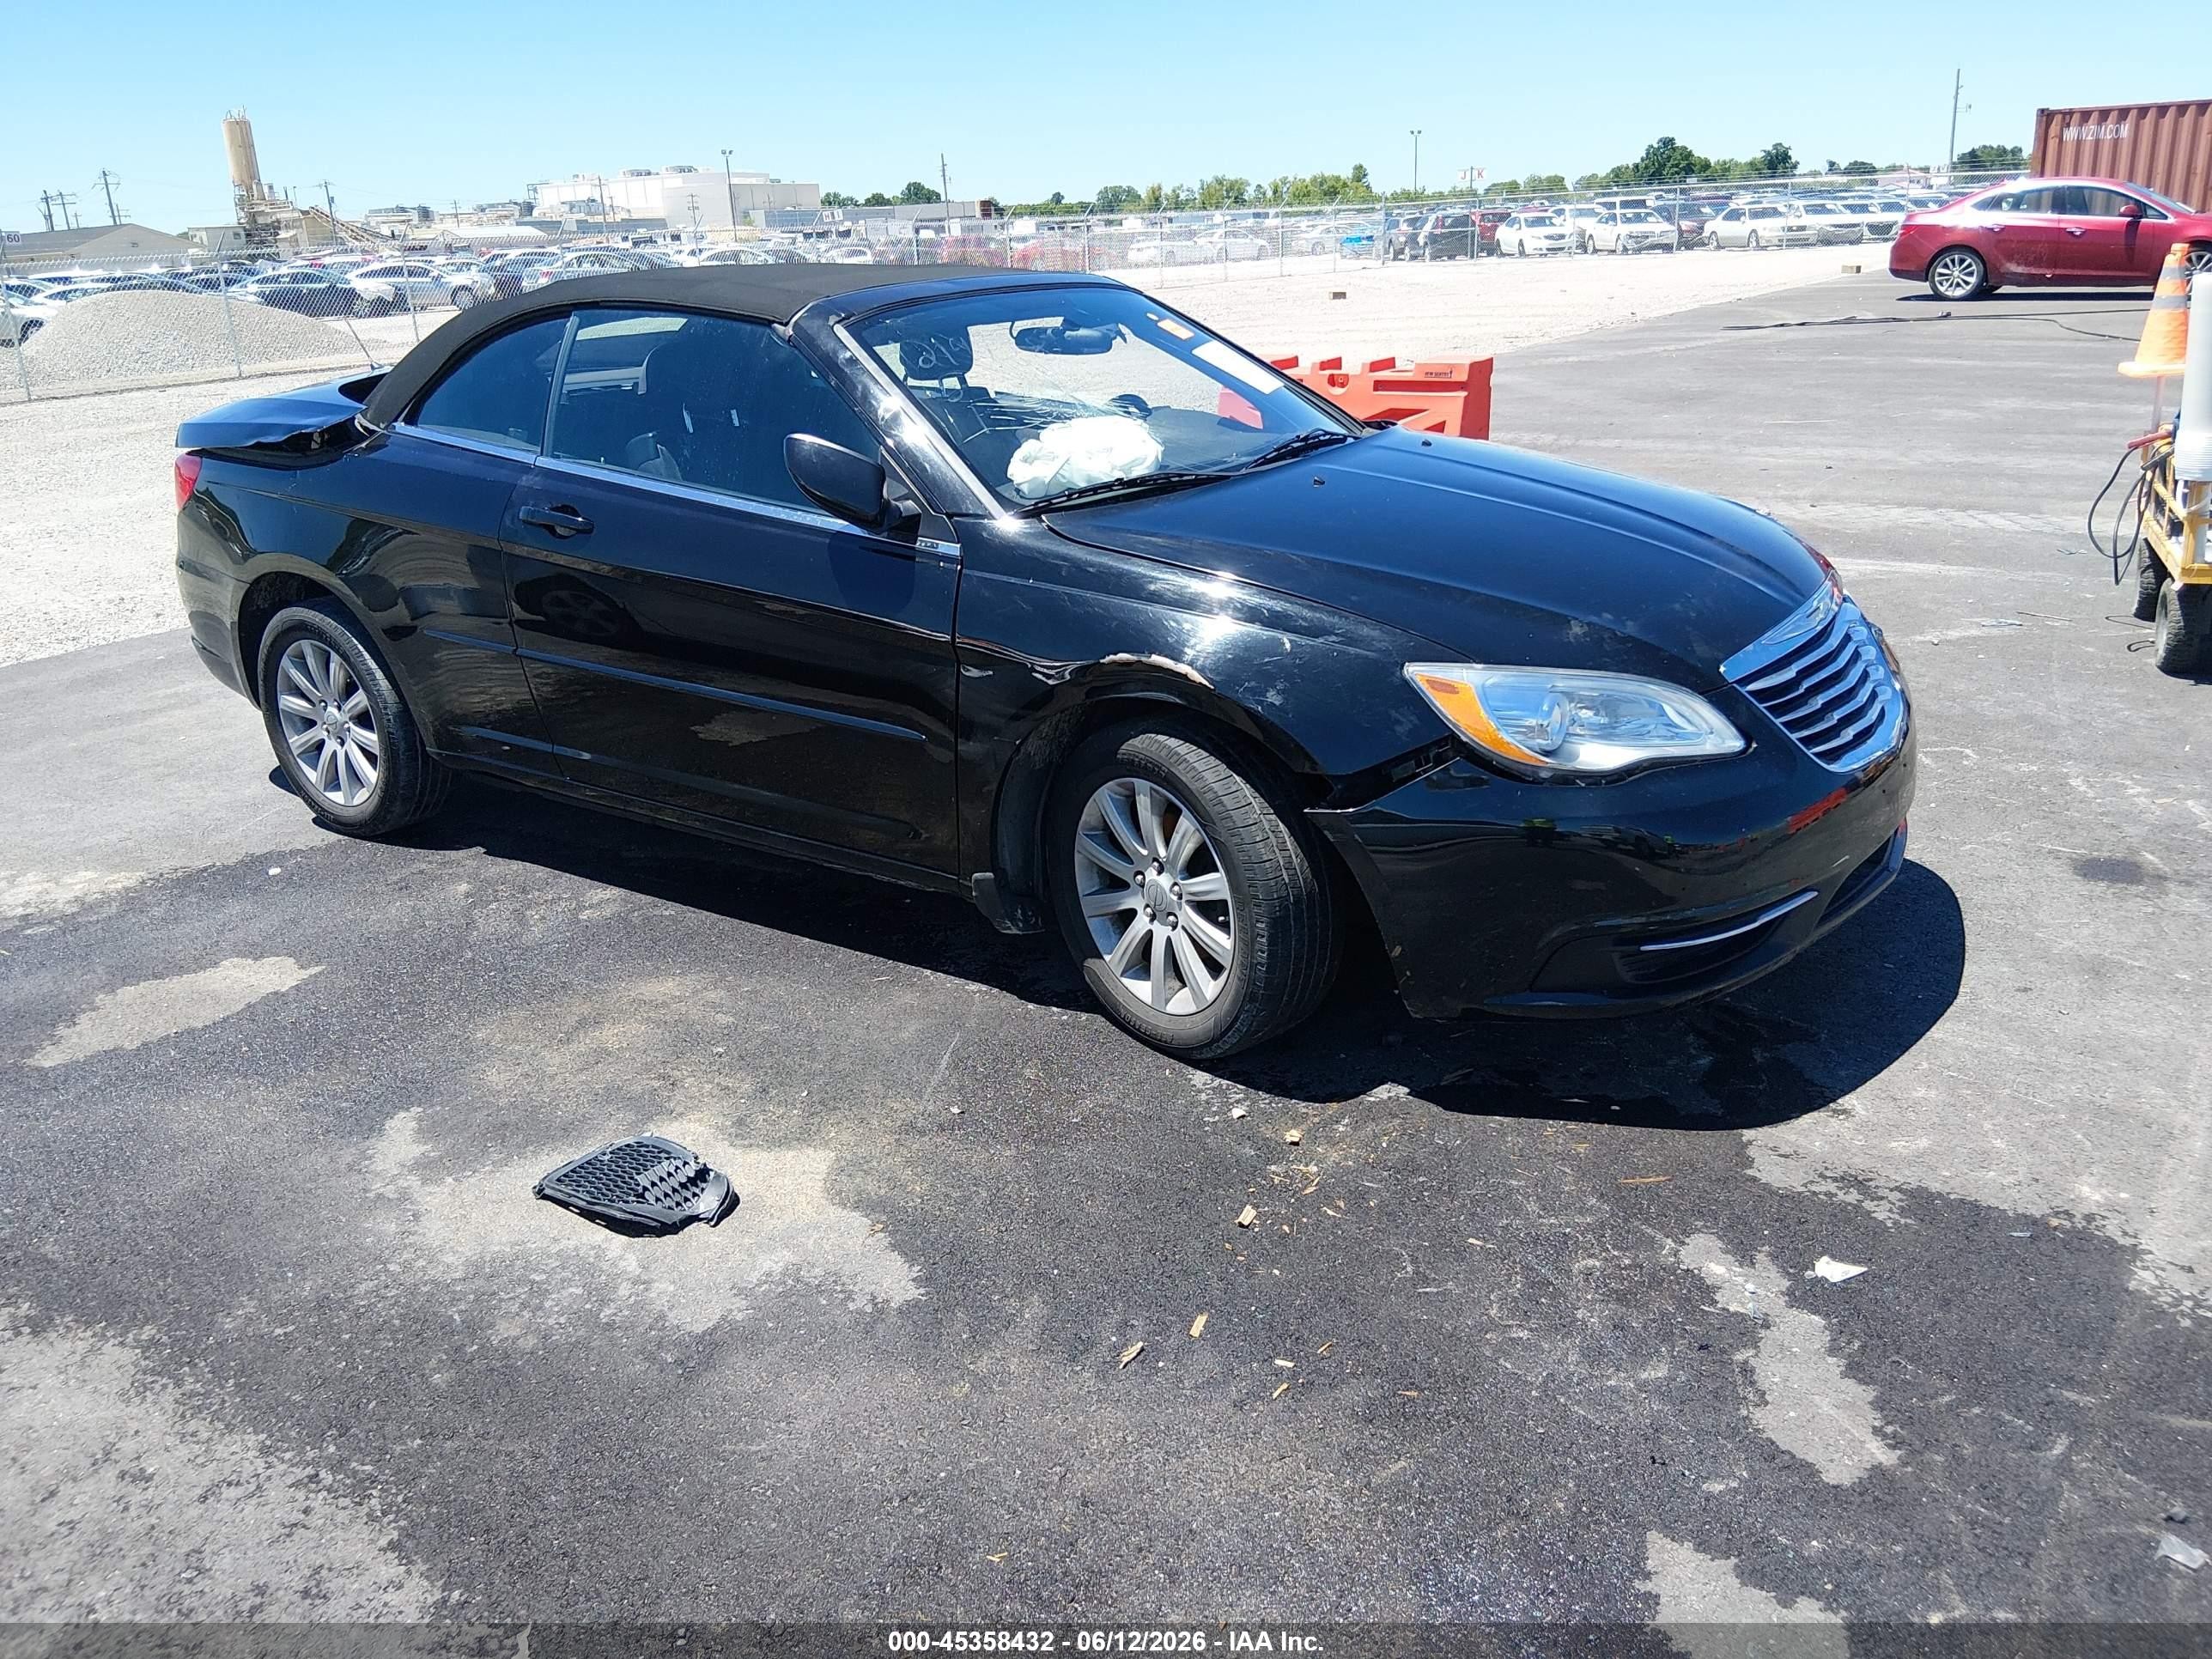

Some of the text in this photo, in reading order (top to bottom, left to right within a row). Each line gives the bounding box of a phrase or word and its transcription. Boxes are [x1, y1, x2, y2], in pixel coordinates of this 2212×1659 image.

[2063, 124, 2129, 142] WWW.ZIM.COM
[1477, 169, 1484, 179] K
[6, 234, 21, 243] 60
